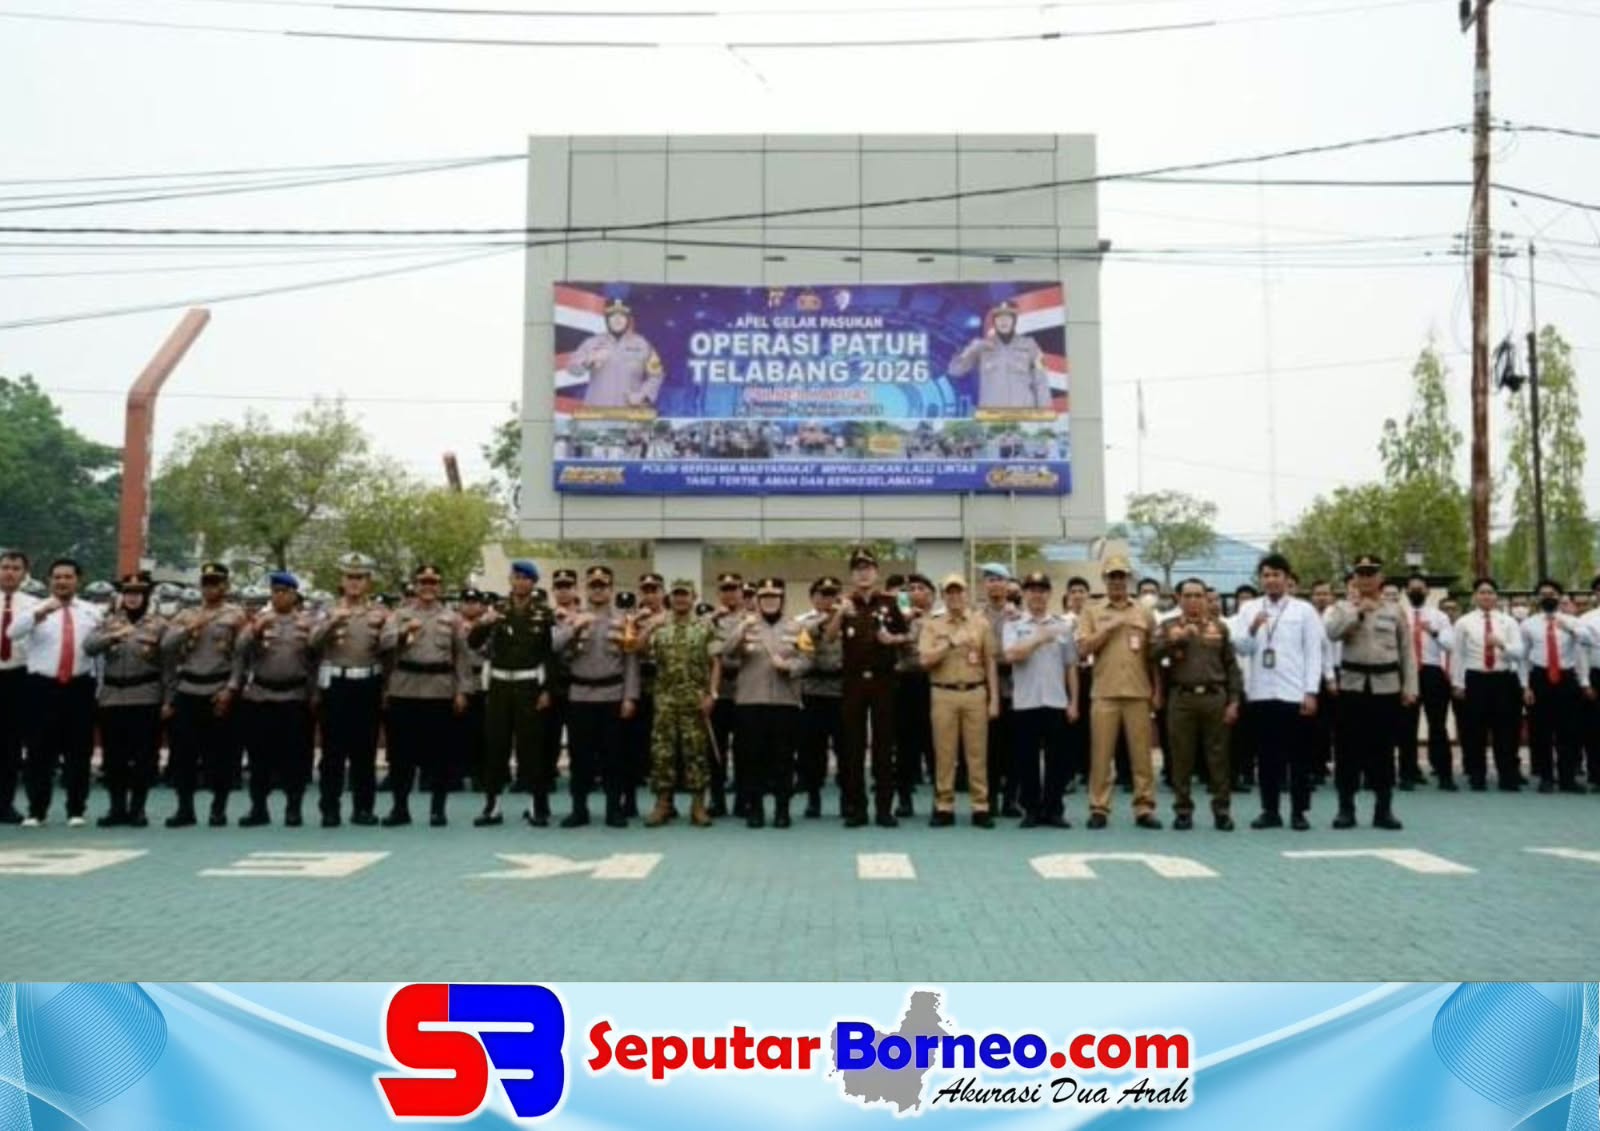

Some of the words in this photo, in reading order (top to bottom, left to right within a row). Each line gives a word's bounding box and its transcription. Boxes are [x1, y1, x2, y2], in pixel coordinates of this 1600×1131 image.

[735, 316, 769, 329] APEL
[773, 316, 817, 329] GELAR
[820, 316, 884, 329] PASUKAN
[690, 332, 820, 356] OPERASI
[831, 332, 929, 356] PATUH
[688, 360, 849, 383] TELABANG
[861, 360, 930, 383] 2026
